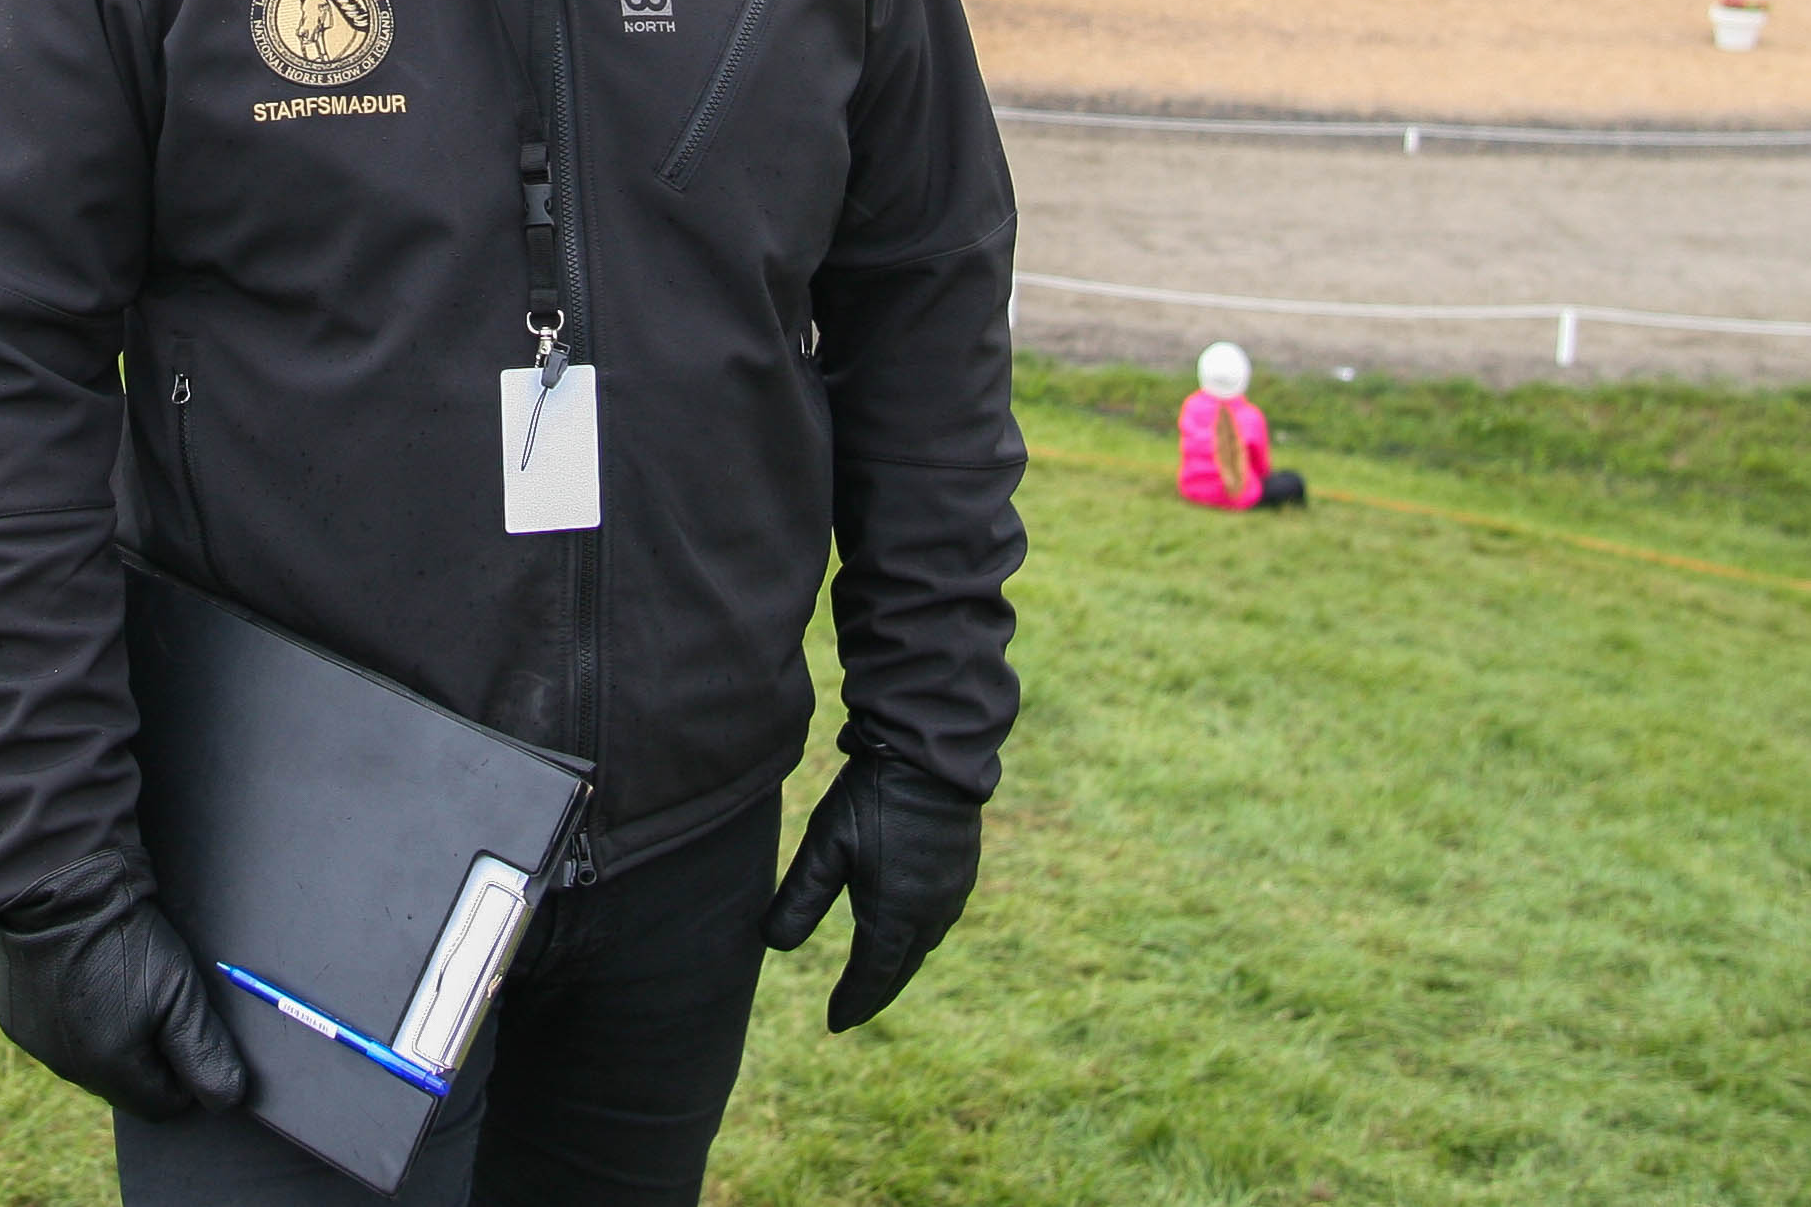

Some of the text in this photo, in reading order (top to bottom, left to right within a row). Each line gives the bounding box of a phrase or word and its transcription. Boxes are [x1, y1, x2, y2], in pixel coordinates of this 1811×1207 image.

[623, 21, 676, 33] NORTH
[253, 10, 391, 84] NATIONAL HORSE SHOW OF ICELAND
[253, 94, 407, 122] STARFSMAÐUR
